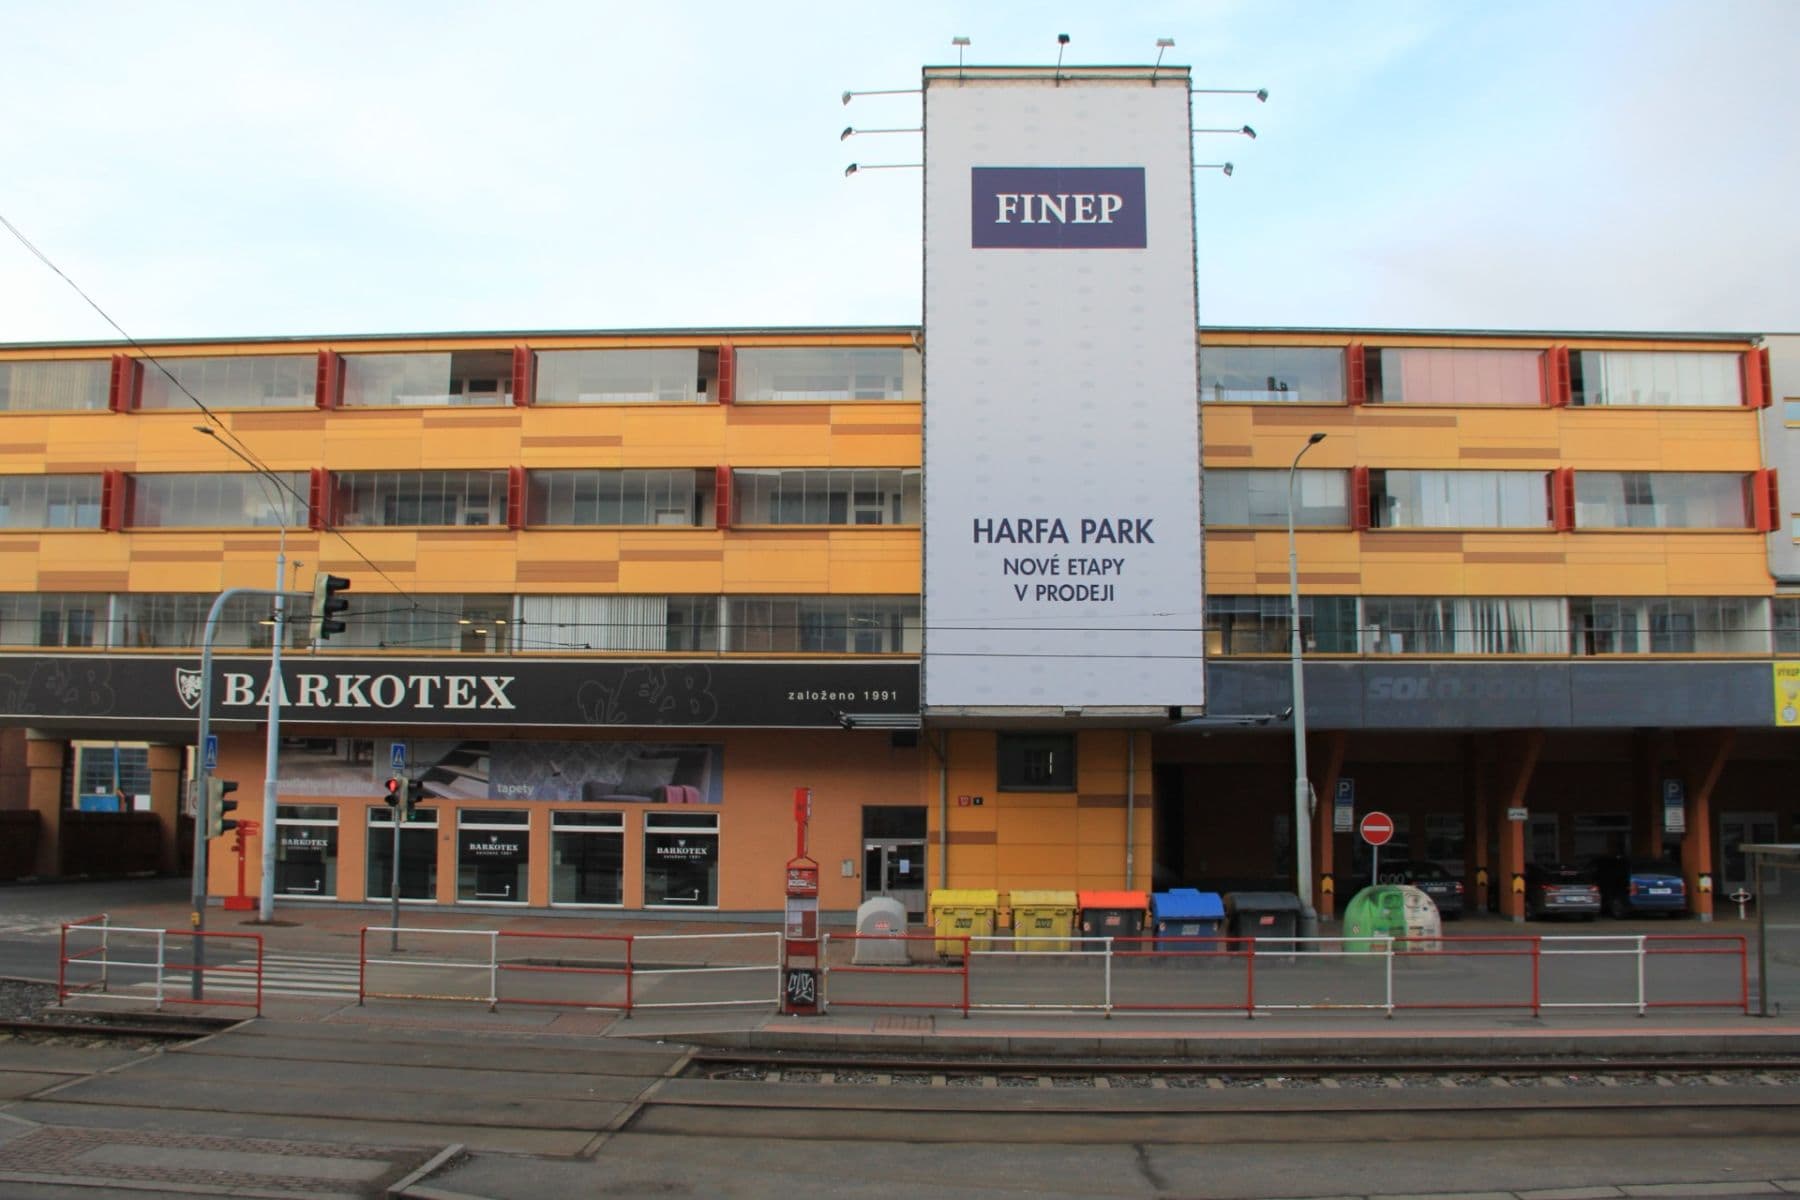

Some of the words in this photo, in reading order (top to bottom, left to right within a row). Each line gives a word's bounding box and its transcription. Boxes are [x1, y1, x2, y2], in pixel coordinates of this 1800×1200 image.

[995, 193, 1123, 224] FINEP
[973, 518, 1069, 544] HARFA
[1081, 518, 1155, 544] PARK
[1003, 554, 1060, 576] NOVÉ
[1067, 558, 1125, 576] ETAPY
[1014, 584, 1029, 601] V
[1036, 584, 1114, 601] PRODEJI
[222, 673, 516, 709] BARKOTEX
[788, 690, 855, 701] založeno
[863, 691, 897, 701] 1991
[497, 784, 535, 796] tapety
[1339, 782, 1350, 797] P
[281, 839, 328, 847] BARKOTEX
[469, 843, 518, 852] BARKOTEX
[656, 847, 708, 855] BARKOTEX
